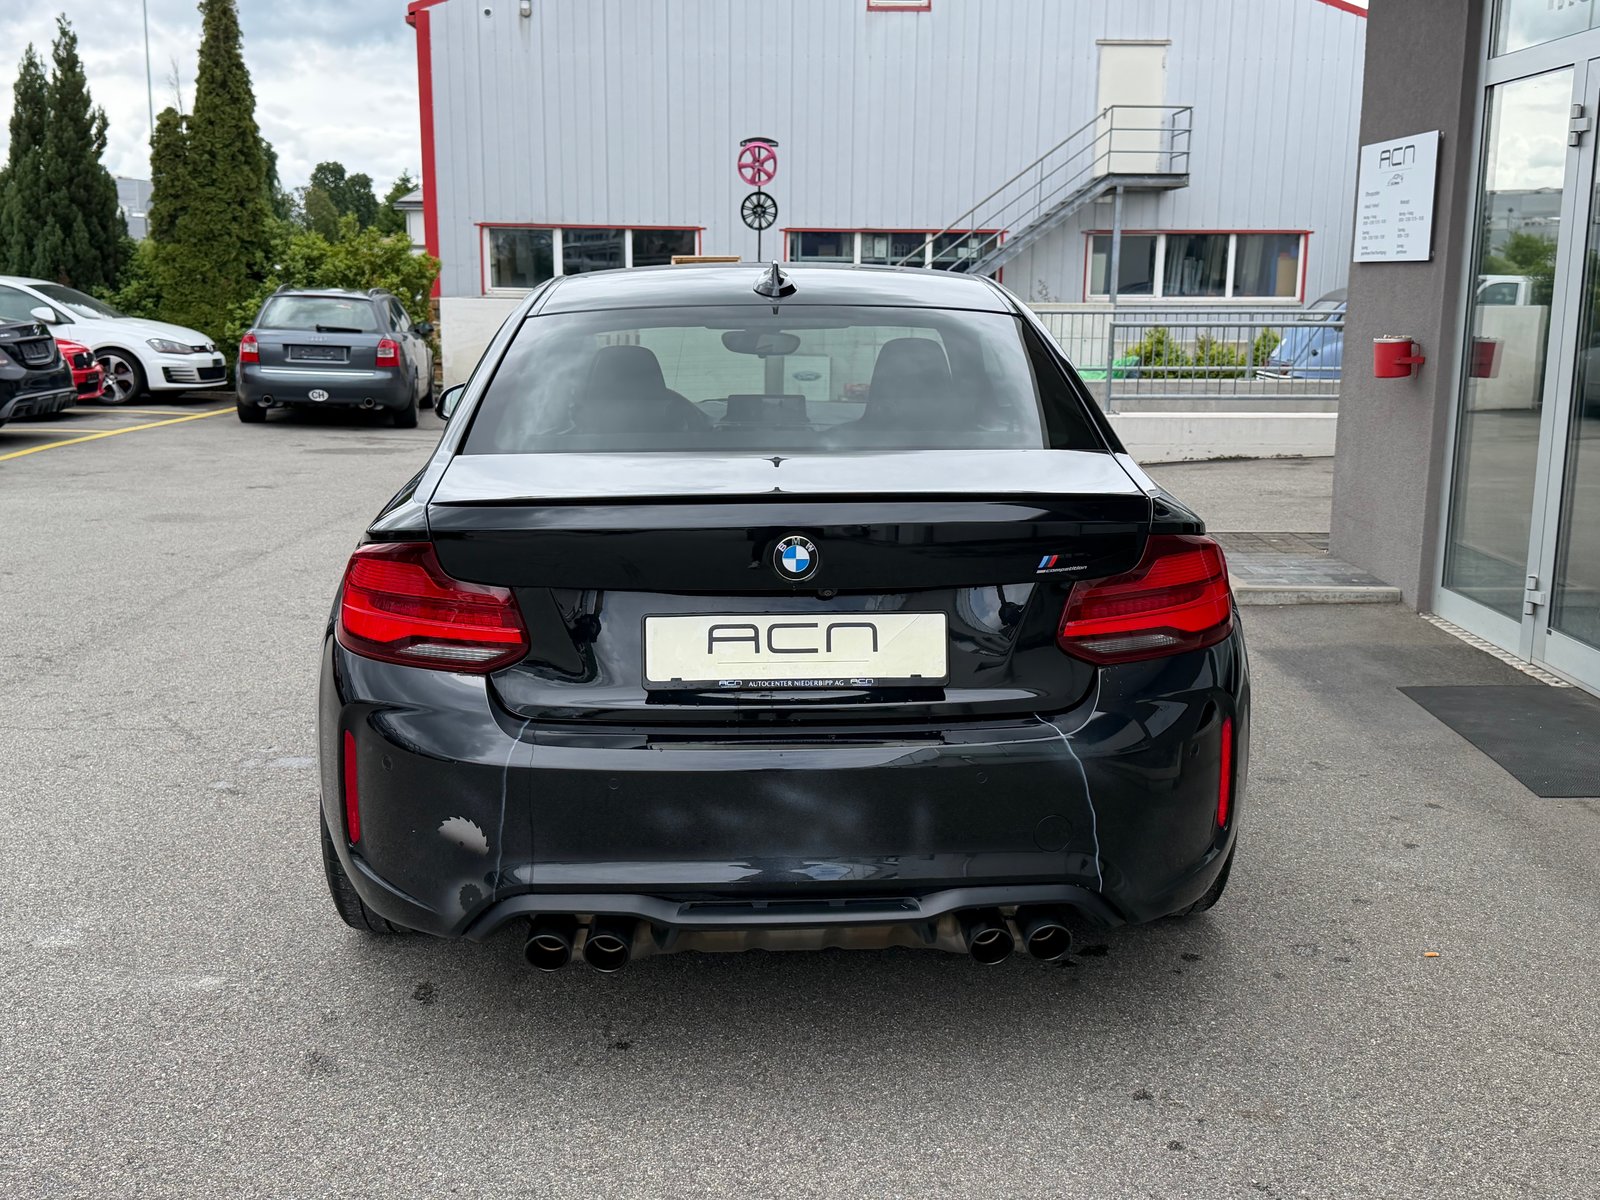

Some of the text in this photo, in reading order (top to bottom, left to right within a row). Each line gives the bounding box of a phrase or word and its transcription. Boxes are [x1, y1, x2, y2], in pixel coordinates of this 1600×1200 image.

[311, 391, 325, 399] CH
[778, 537, 815, 552] BMW
[708, 623, 878, 654] ACN
